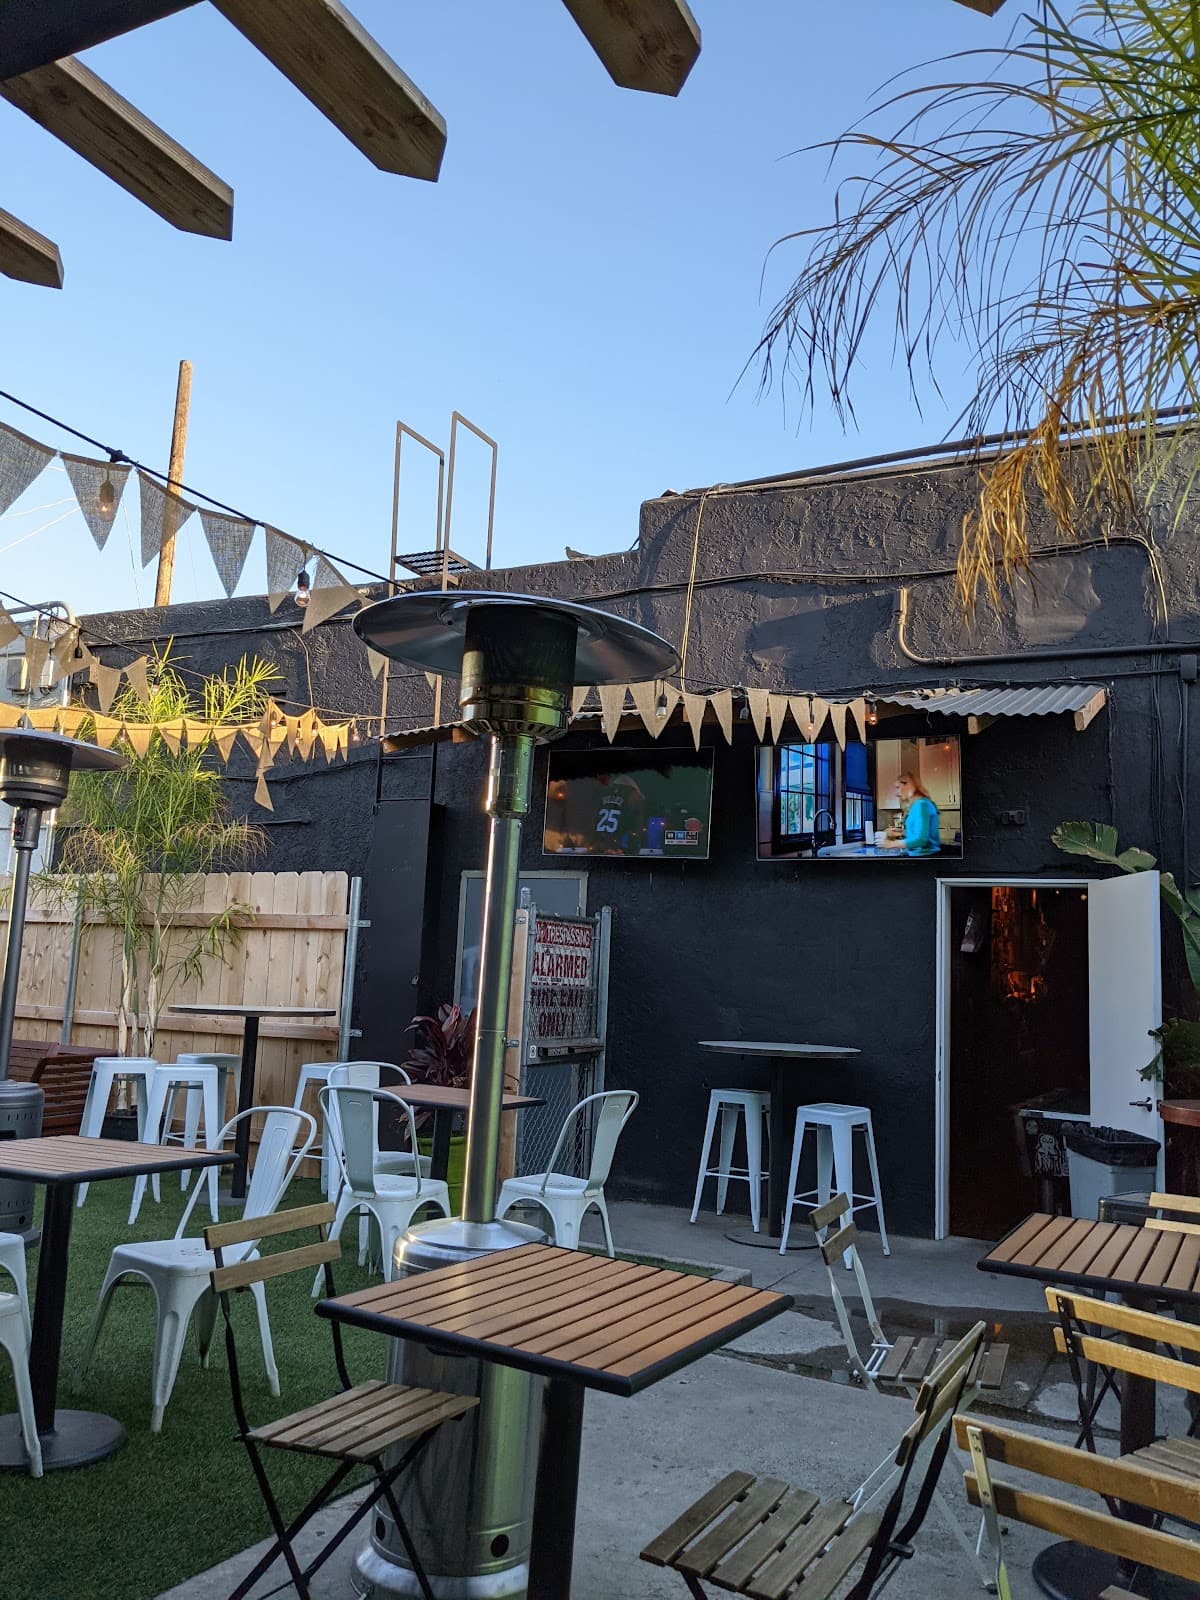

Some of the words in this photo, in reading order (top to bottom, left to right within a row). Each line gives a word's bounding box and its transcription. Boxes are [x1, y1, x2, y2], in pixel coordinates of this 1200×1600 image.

[596, 808, 622, 833] 25
[547, 925, 590, 946] TRESPASSING
[533, 952, 588, 978] ALARMED
